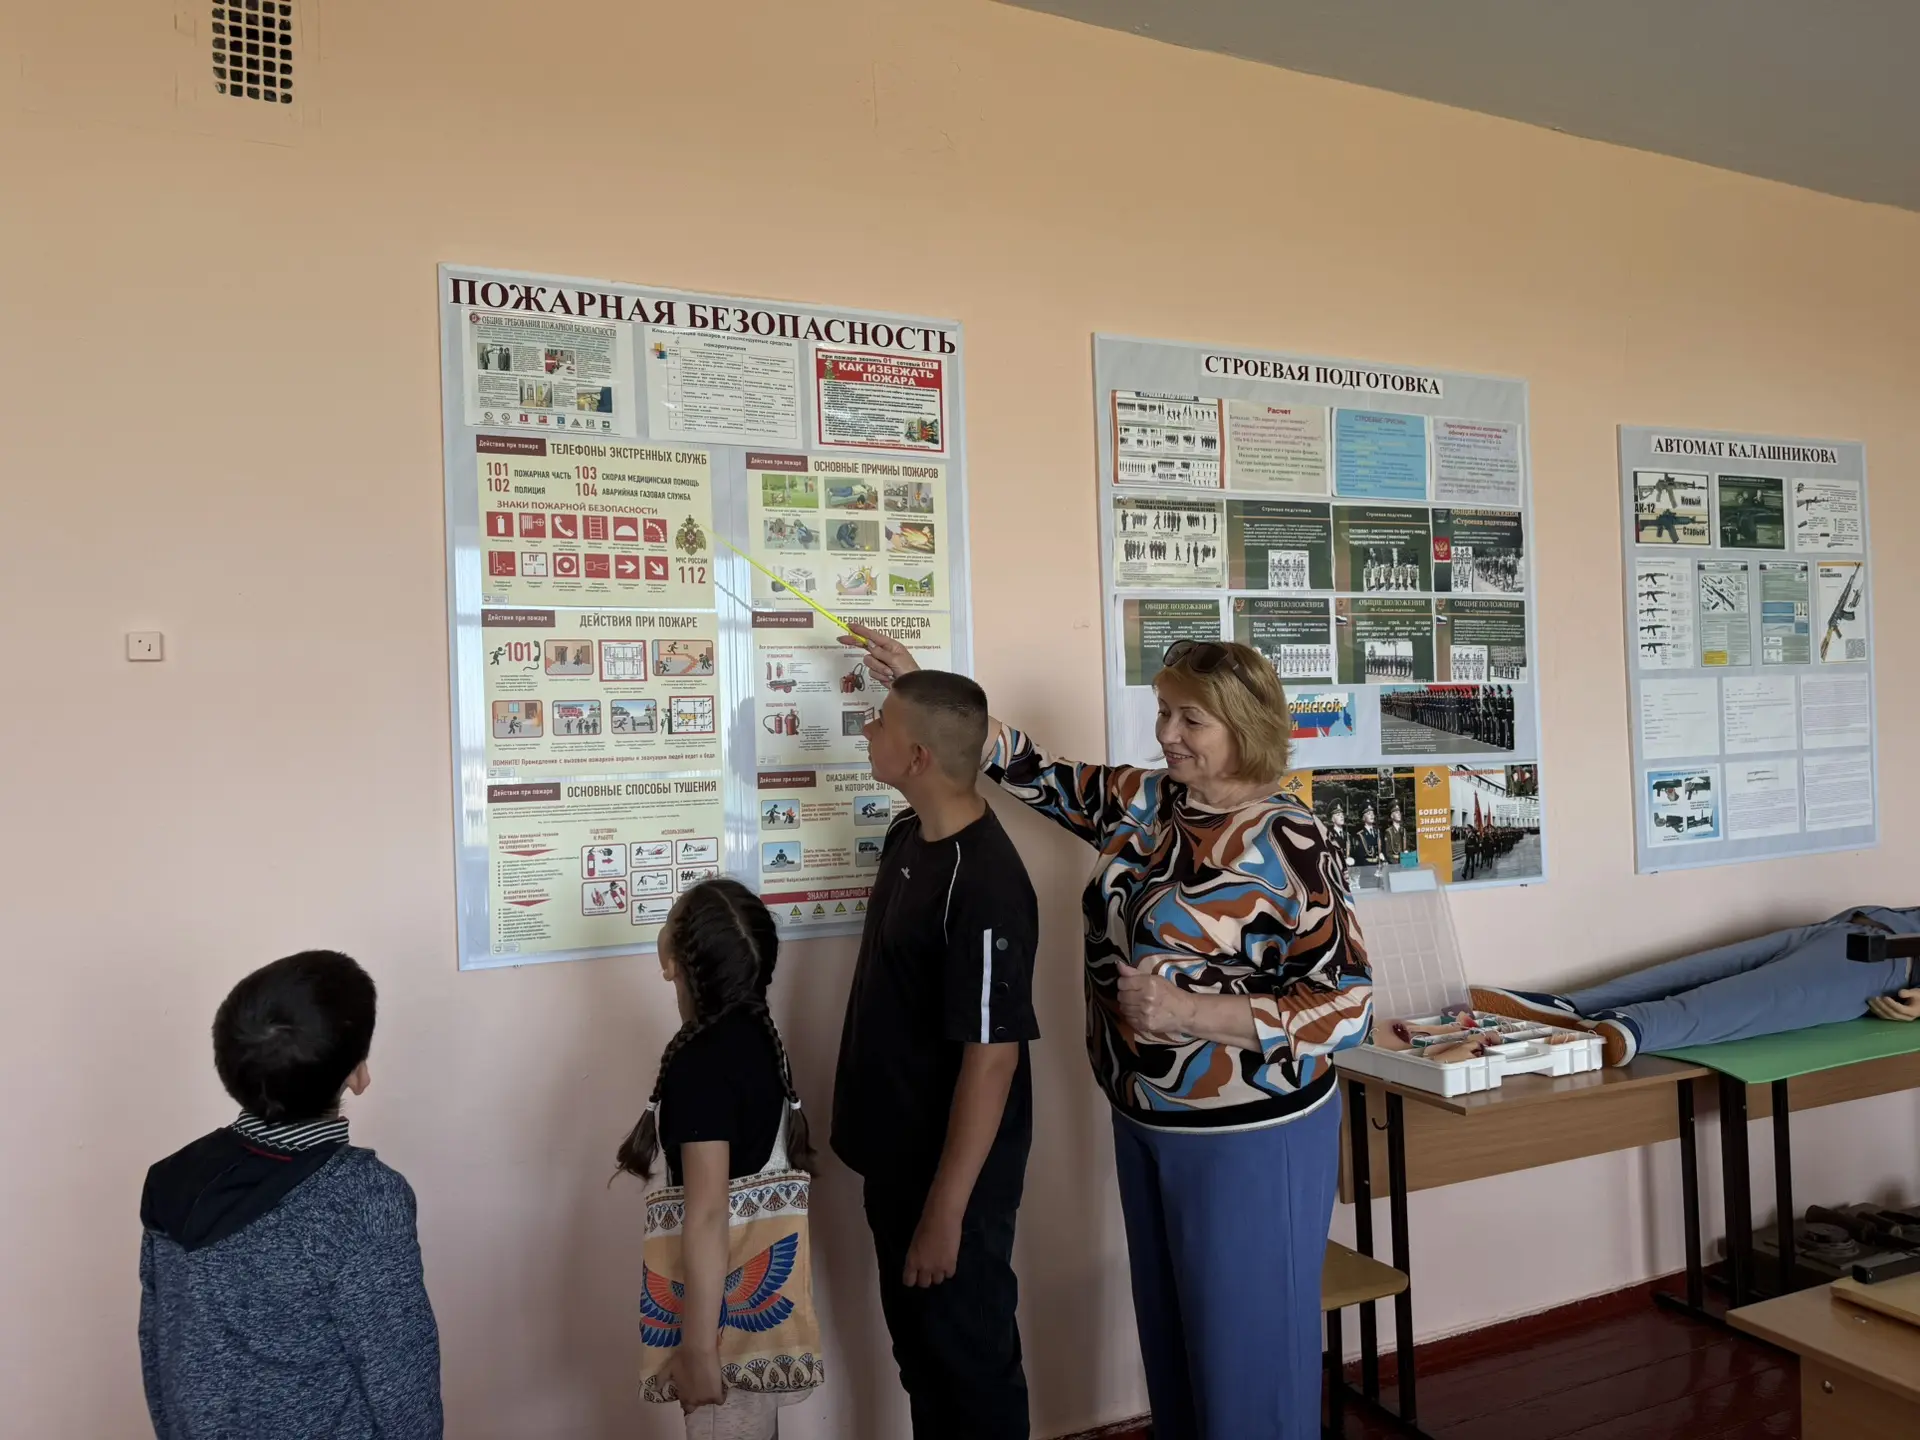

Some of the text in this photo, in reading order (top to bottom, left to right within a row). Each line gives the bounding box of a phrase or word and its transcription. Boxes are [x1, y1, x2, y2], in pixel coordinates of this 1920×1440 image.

[449, 277, 956, 354] ПОЖАРНАЯ БЕЗОПАСНОСТЬ
[482, 315, 617, 337] ОБЩИЕ ТРЕБОВАНИЯ ПОЖАРНОЙ БЕЗОПАСНОСТИ
[821, 353, 833, 361] при
[883, 357, 892, 365] 01
[838, 361, 935, 379] КАК ИЗБЕЖАТЬ
[1204, 355, 1441, 395] СТРОЕВАЯ ПОДГОТОВКА
[862, 373, 916, 386] ПОЖАРА
[1267, 407, 1292, 415] Расчет
[479, 439, 506, 448] Действия
[550, 443, 707, 465] ТЕЛЕФОНЫ ЭКСТРЕННЫХ СЛУЖБ
[1654, 437, 1837, 464] АВТОМАТ КАЛАШНИКОВА
[751, 457, 774, 465] Действия
[486, 462, 572, 480] 101 ПОЖАРНАЯ ЧАСТЬ
[814, 460, 939, 479] ОСНОВНЫЕ ПРИЧИНЫ ПОЖАРОВ
[575, 465, 700, 487] 103 СКОРАЯ МЕДИЦИНСКАЯ ПОМОЩЬ
[487, 477, 546, 495] 102 ПОЛИЦИЯ
[576, 482, 691, 501] 104 АВАРИЙНАЯ ГАЗОВАЯ СЛУЖБА
[1681, 495, 1702, 506] Новый
[496, 500, 659, 515] ЗНАКИ ПОЖАРНОЙ БЕЗОПАСНОСТИ
[1635, 502, 1656, 514] АК-12
[1453, 518, 1483, 526] «Строевая
[1682, 526, 1706, 536] Старый
[529, 554, 539, 562] ПГ
[687, 557, 708, 565] РОССИИ
[678, 566, 706, 584] 112
[1358, 599, 1425, 607] ОБЩИЕ ПОЛОЖЕНИЯ
[1479, 600, 1520, 608] ПОЛОЖЕНИЯ
[487, 613, 514, 622] Действия
[579, 612, 698, 628] ДЕЙСТВИЯ ПРИ ПОЖАРЕ
[891, 617, 931, 628] СРЕДСТВА
[505, 641, 531, 662] 101
[1288, 699, 1342, 713] ОИНСКОЙ
[492, 759, 520, 767] ПОМНИТЕ!
[521, 758, 557, 767] Промедление
[759, 776, 782, 784] Действия
[825, 773, 858, 782] ОКАЗАНИЕ
[492, 788, 520, 798] Действия
[532, 788, 553, 796] пожаре
[567, 780, 717, 798] ОСНОВНЫЕ СПОСОБЫ ТУШЕНИЯ
[834, 783, 874, 792] НА КОТОРОМ
[1418, 808, 1448, 816] БОЕВОЕ
[1420, 816, 1447, 825] ЗНАМЯ
[1417, 826, 1451, 834] ВОИНСКОЙ
[807, 888, 866, 901] ЗНАКИ ПОЖАРНОЙ
